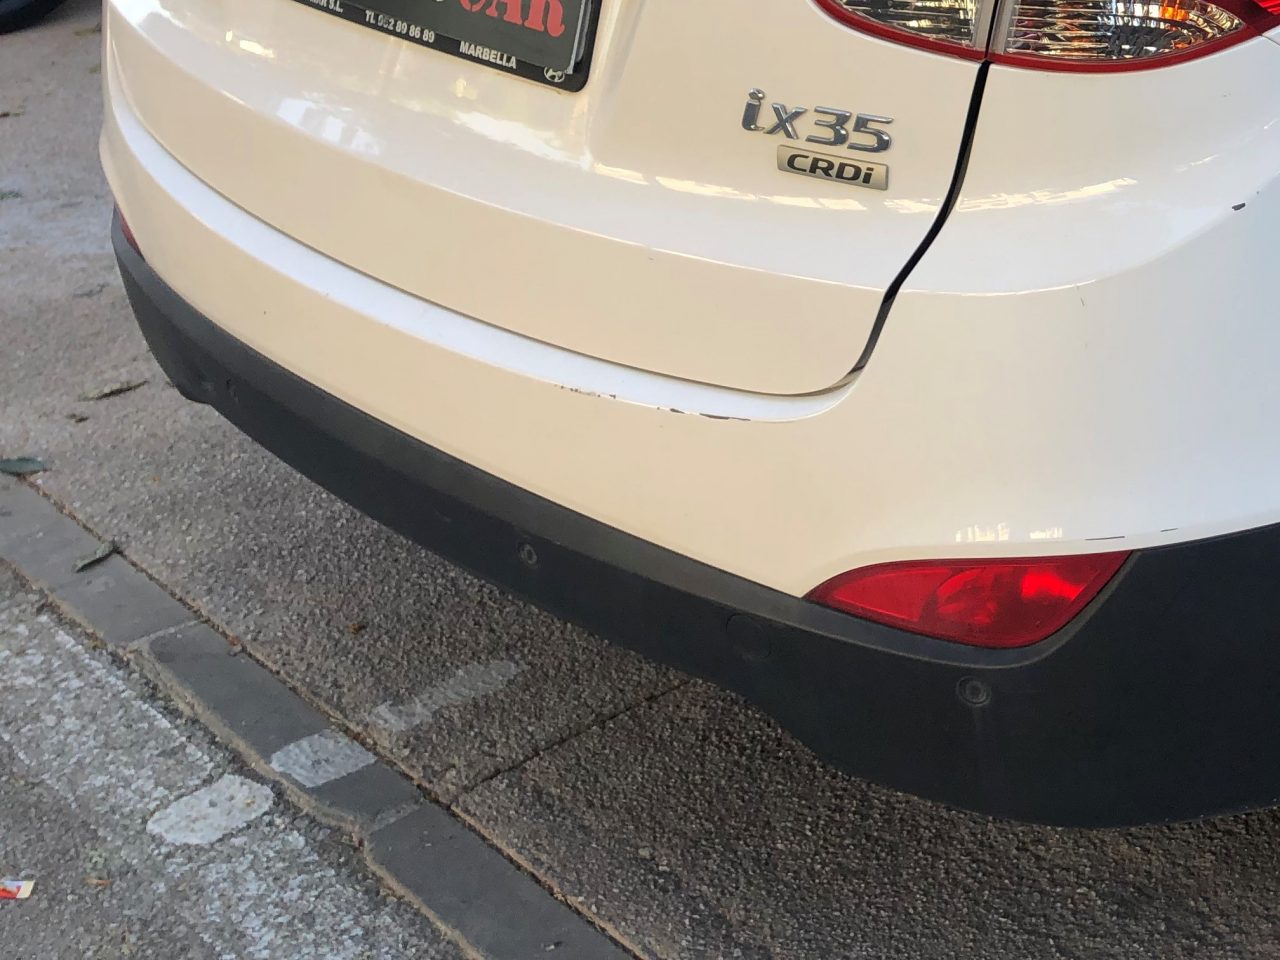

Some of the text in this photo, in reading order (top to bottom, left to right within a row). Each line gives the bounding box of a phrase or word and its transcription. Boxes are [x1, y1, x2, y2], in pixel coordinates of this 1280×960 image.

[395, 20, 408, 35] 89
[459, 40, 518, 70] MARBELLA
[741, 87, 895, 153] ix35
[786, 152, 875, 185] CRDi
